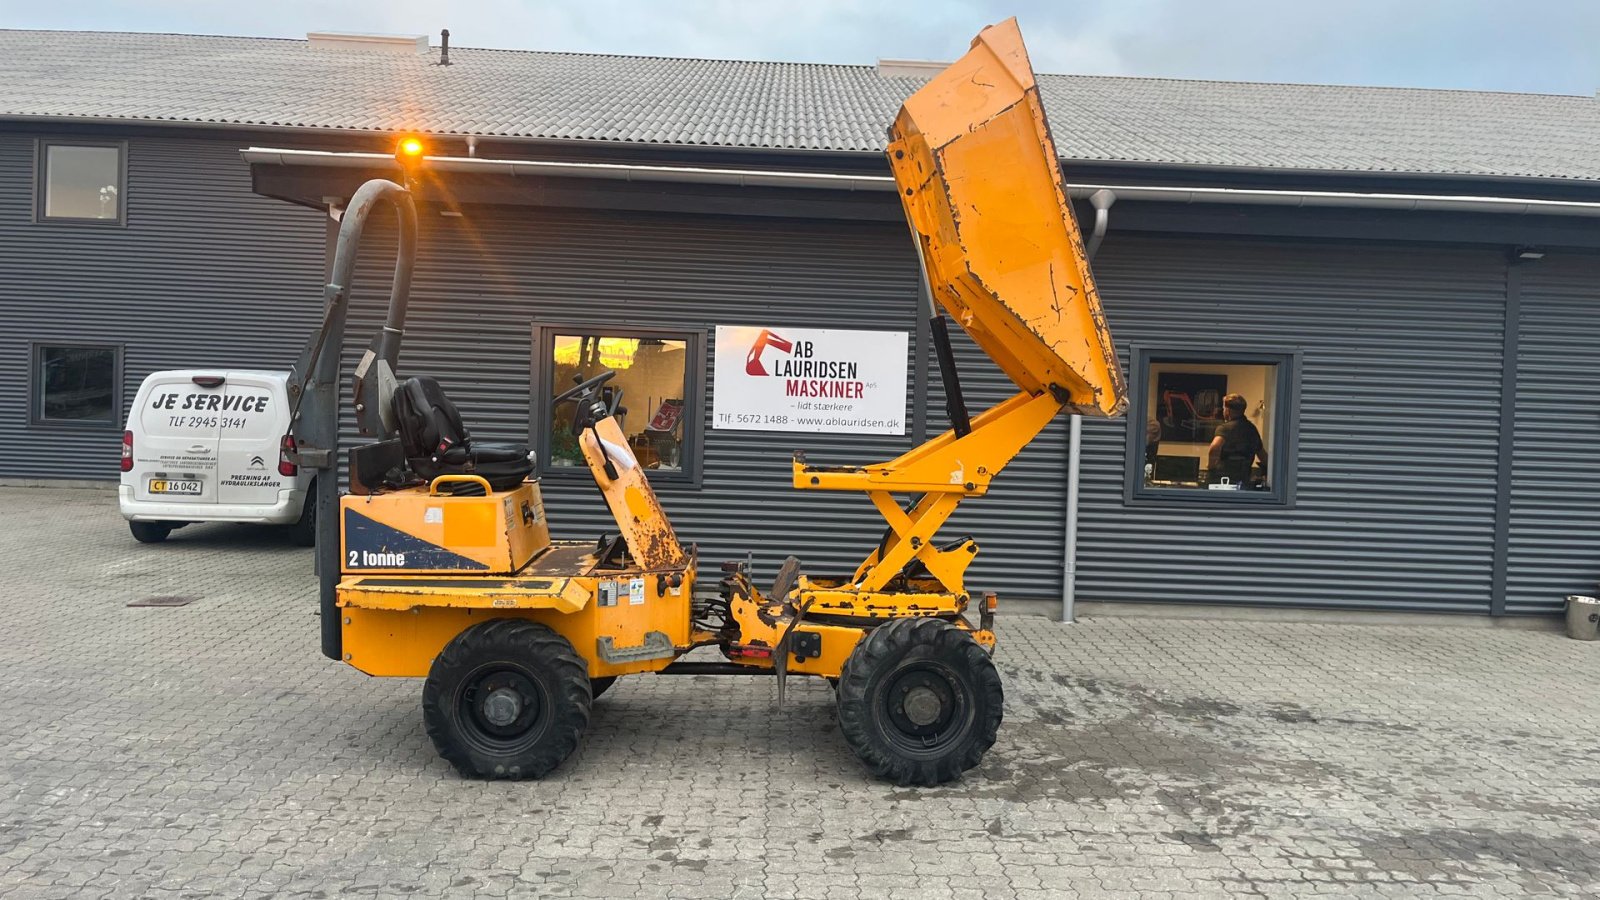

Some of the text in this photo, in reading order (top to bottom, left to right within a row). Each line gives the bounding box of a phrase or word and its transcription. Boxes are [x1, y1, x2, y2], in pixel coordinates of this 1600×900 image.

[794, 341, 814, 358] AB
[775, 359, 858, 379] LAURIDSEN
[786, 379, 877, 399] MASKINER ApS
[152, 393, 269, 413] JE SERVICE
[797, 401, 812, 411] lidt
[813, 402, 853, 412] stærkere
[169, 416, 247, 429] TLF 2945 3141
[718, 413, 734, 424] Tlf.
[736, 414, 761, 424] 5672
[764, 415, 788, 425] 1488
[797, 416, 900, 429] www.ablauridsen.dk
[154, 481, 198, 491] CT 16 042
[220, 480, 281, 488] HYDRAULIKSLANGER
[348, 550, 405, 566] 2 tonne
